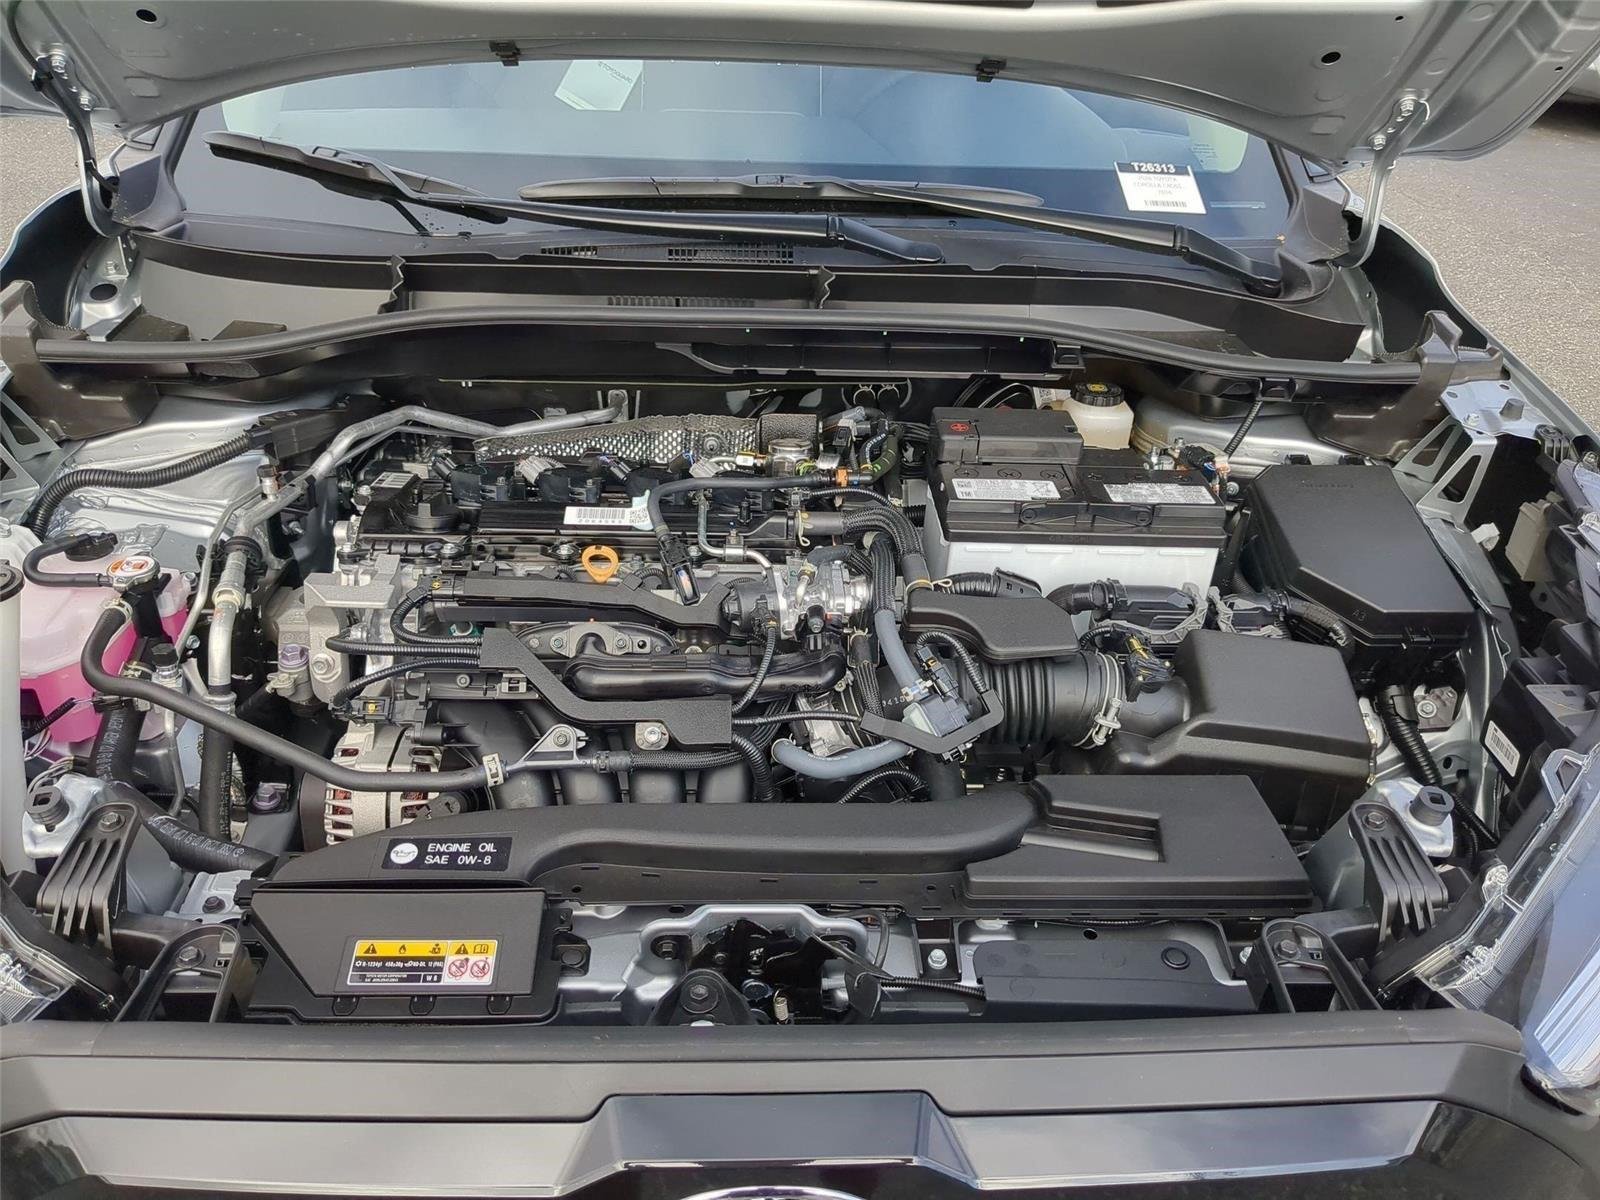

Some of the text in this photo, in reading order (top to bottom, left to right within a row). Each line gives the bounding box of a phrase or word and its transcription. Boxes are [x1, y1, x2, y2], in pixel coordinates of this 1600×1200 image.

[1130, 162, 1176, 173] T26313
[427, 843, 497, 852] ENGINE OIL
[424, 855, 449, 865] SAE
